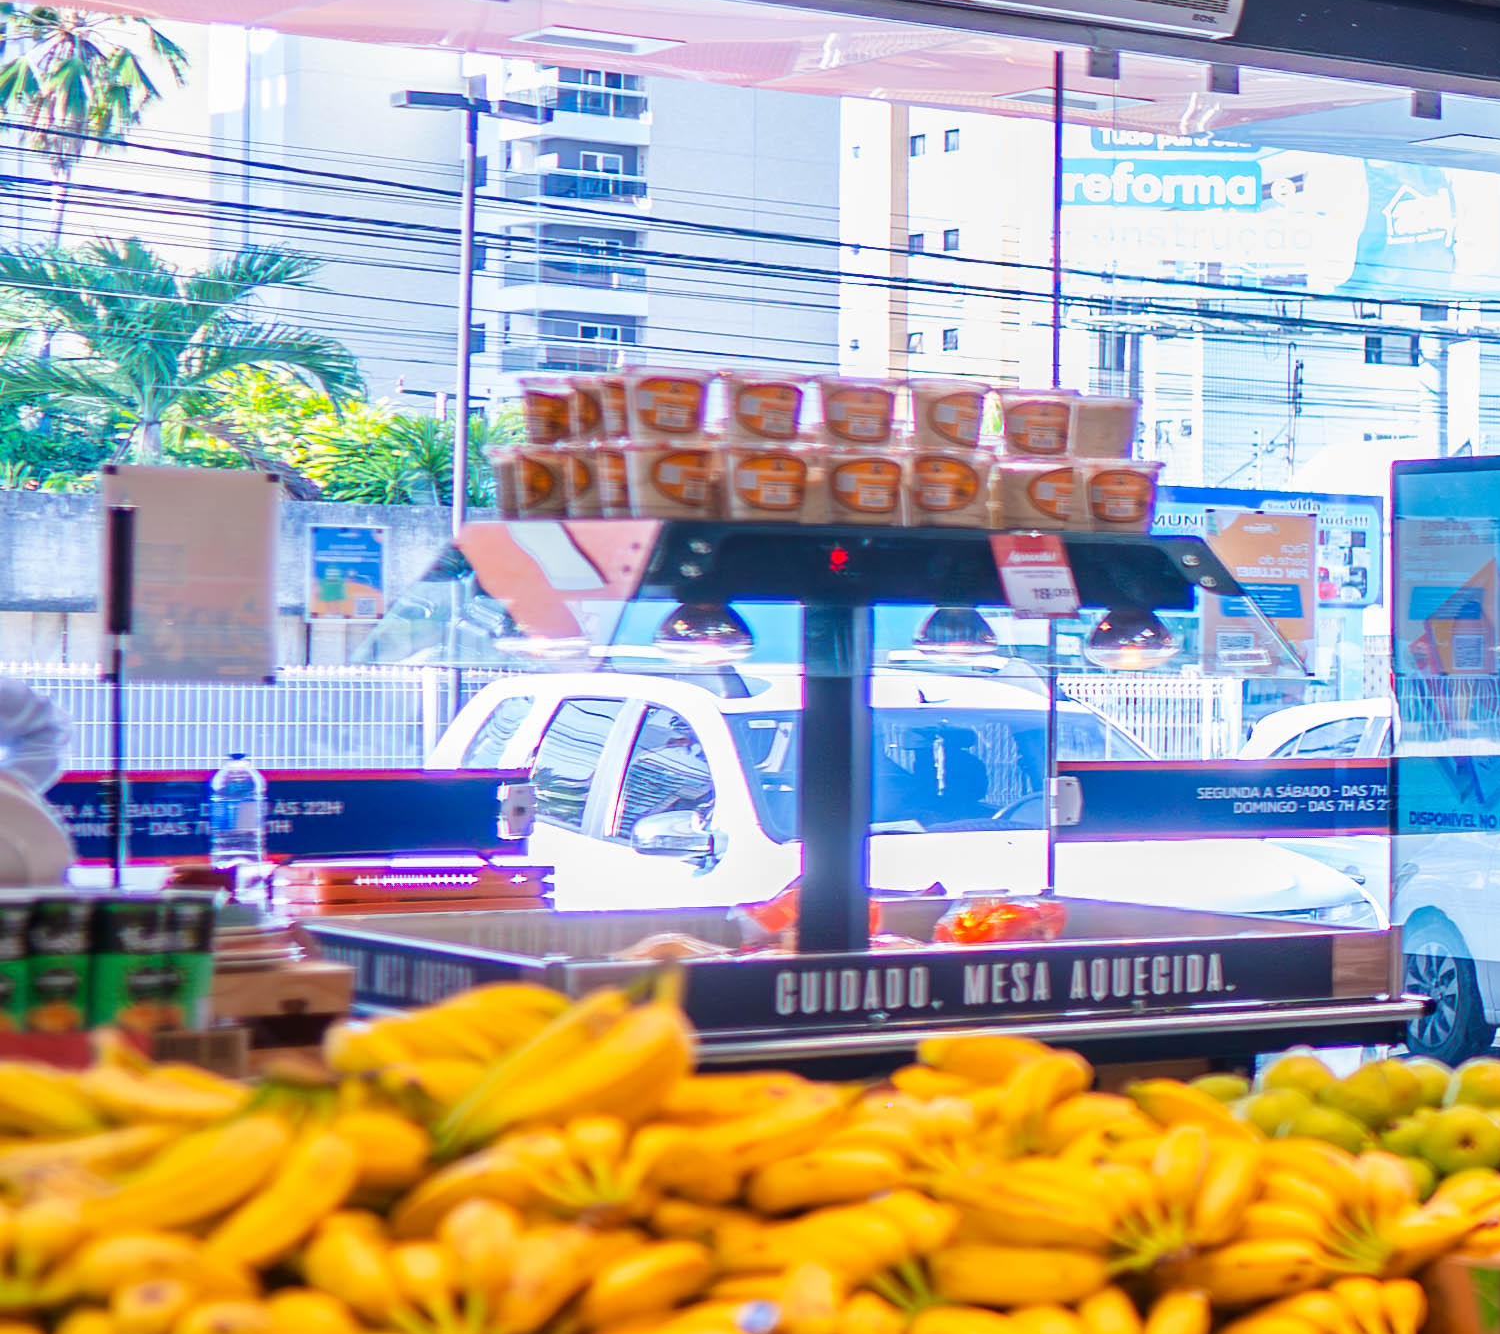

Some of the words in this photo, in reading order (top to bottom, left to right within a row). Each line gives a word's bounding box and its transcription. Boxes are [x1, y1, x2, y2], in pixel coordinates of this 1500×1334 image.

[1061, 160, 1257, 205] reforma
[1270, 175, 1298, 203] e
[1196, 786, 1262, 800] SEGUNDA
[1263, 786, 1274, 799] A
[1275, 783, 1332, 799] SÁBADO
[1341, 785, 1368, 798] DAS
[1232, 801, 1298, 815] DOMINGO
[1308, 799, 1336, 813] DAS
[1337, 799, 1356, 813] 7H
[1357, 796, 1375, 812] ÀS
[1408, 808, 1477, 827] DISPONÍVEL
[1479, 814, 1498, 829] NO
[962, 960, 1052, 1006] MESA
